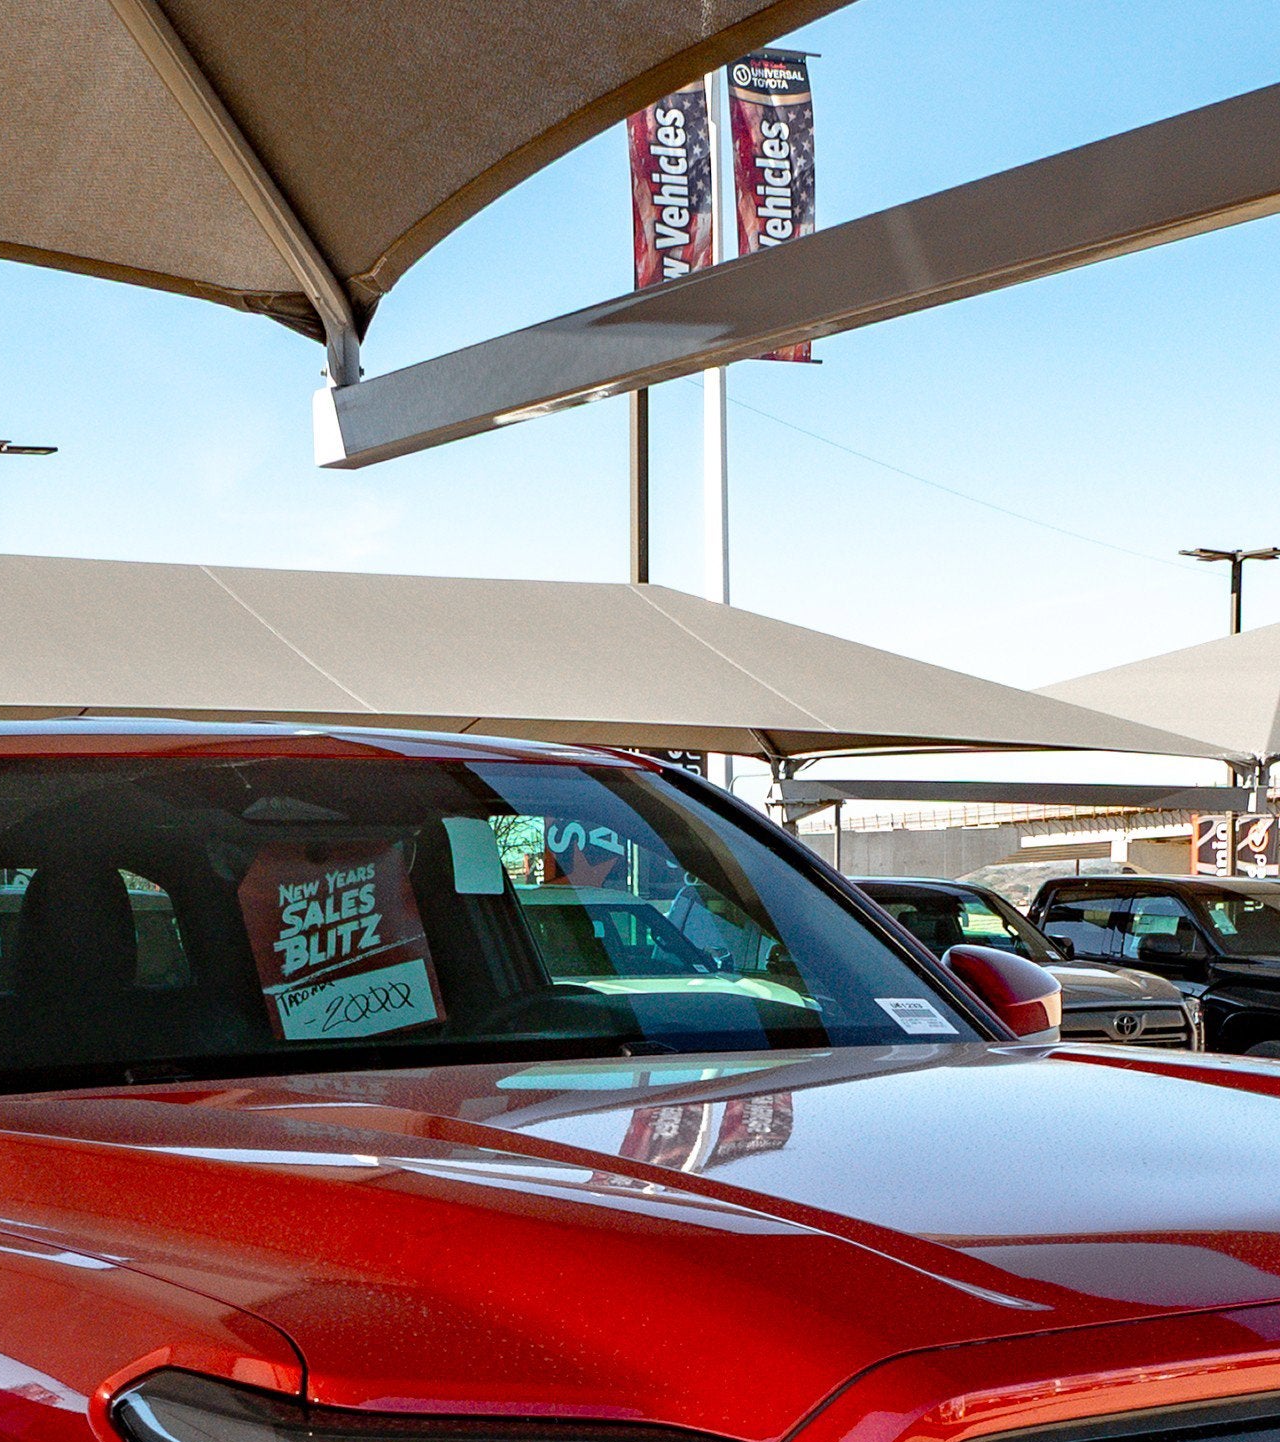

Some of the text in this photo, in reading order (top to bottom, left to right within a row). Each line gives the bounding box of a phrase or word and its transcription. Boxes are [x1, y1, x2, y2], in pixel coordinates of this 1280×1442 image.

[751, 67, 805, 81] UNIVERSAL
[752, 77, 789, 89] TOYOTA
[650, 107, 690, 250] Vehicles
[278, 863, 376, 907] NEW YEARS
[280, 883, 376, 940] SALES
[273, 912, 383, 977] BLITZ
